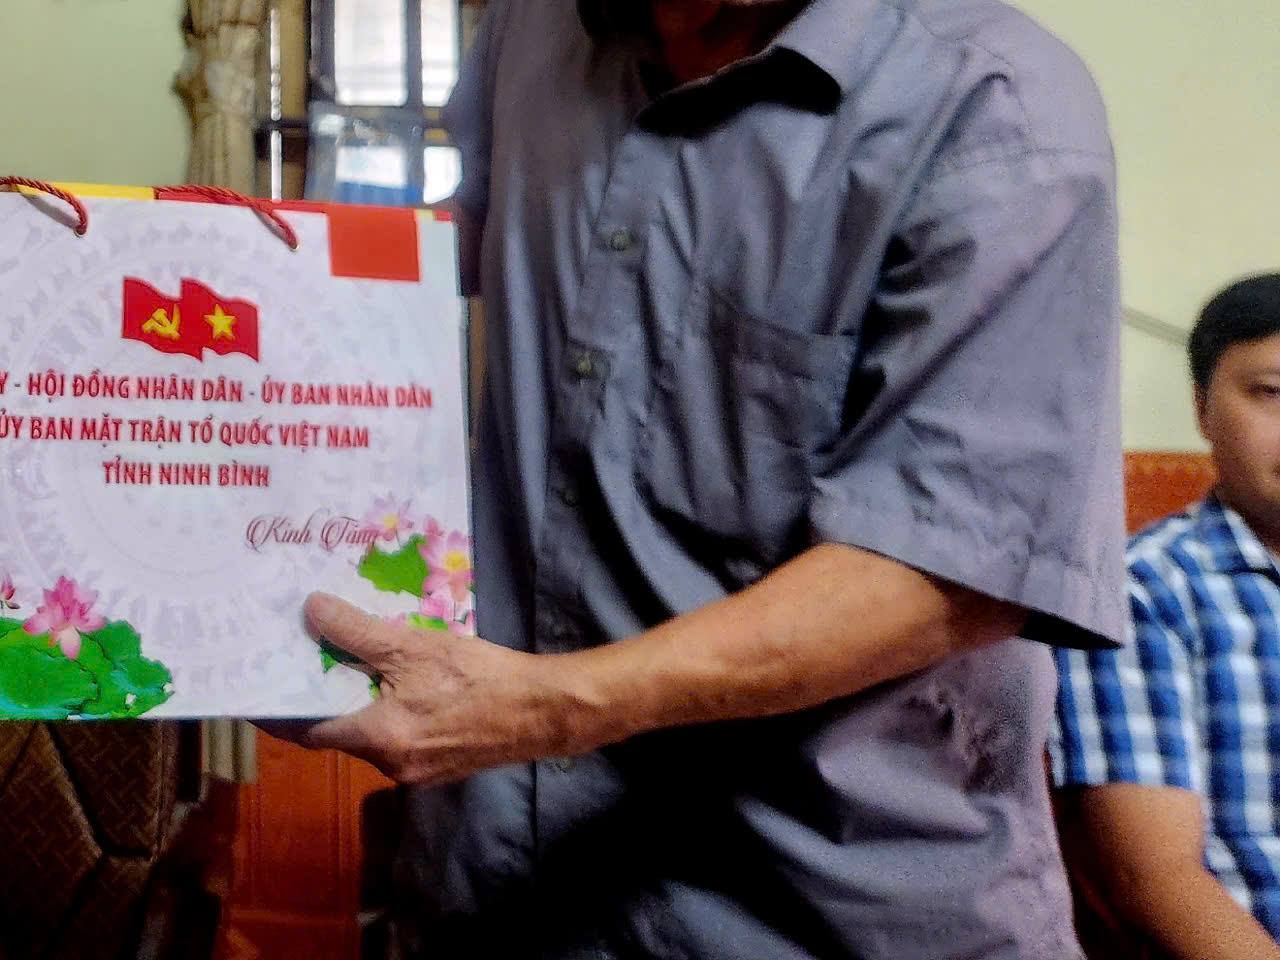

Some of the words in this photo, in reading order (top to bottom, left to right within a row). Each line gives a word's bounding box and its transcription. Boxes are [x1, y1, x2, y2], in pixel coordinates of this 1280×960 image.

[28, 368, 65, 403] HỘI
[72, 367, 130, 399] ĐỒNG
[137, 373, 194, 401] NHÂN
[201, 373, 243, 402] DÂN
[291, 383, 331, 406] BAN
[336, 382, 389, 408] NHÂN
[395, 382, 433, 409] DÂN
[30, 416, 73, 440] BAN
[80, 411, 123, 448] MẶT
[128, 415, 181, 449] TRẬN
[188, 412, 213, 444] TỔ
[220, 416, 273, 447] QUỐC
[279, 420, 321, 453] VIỆT
[326, 424, 370, 448] NAM
[103, 455, 152, 485] TỈNH
[159, 463, 211, 486] NINH
[218, 460, 270, 487] BÌNH
